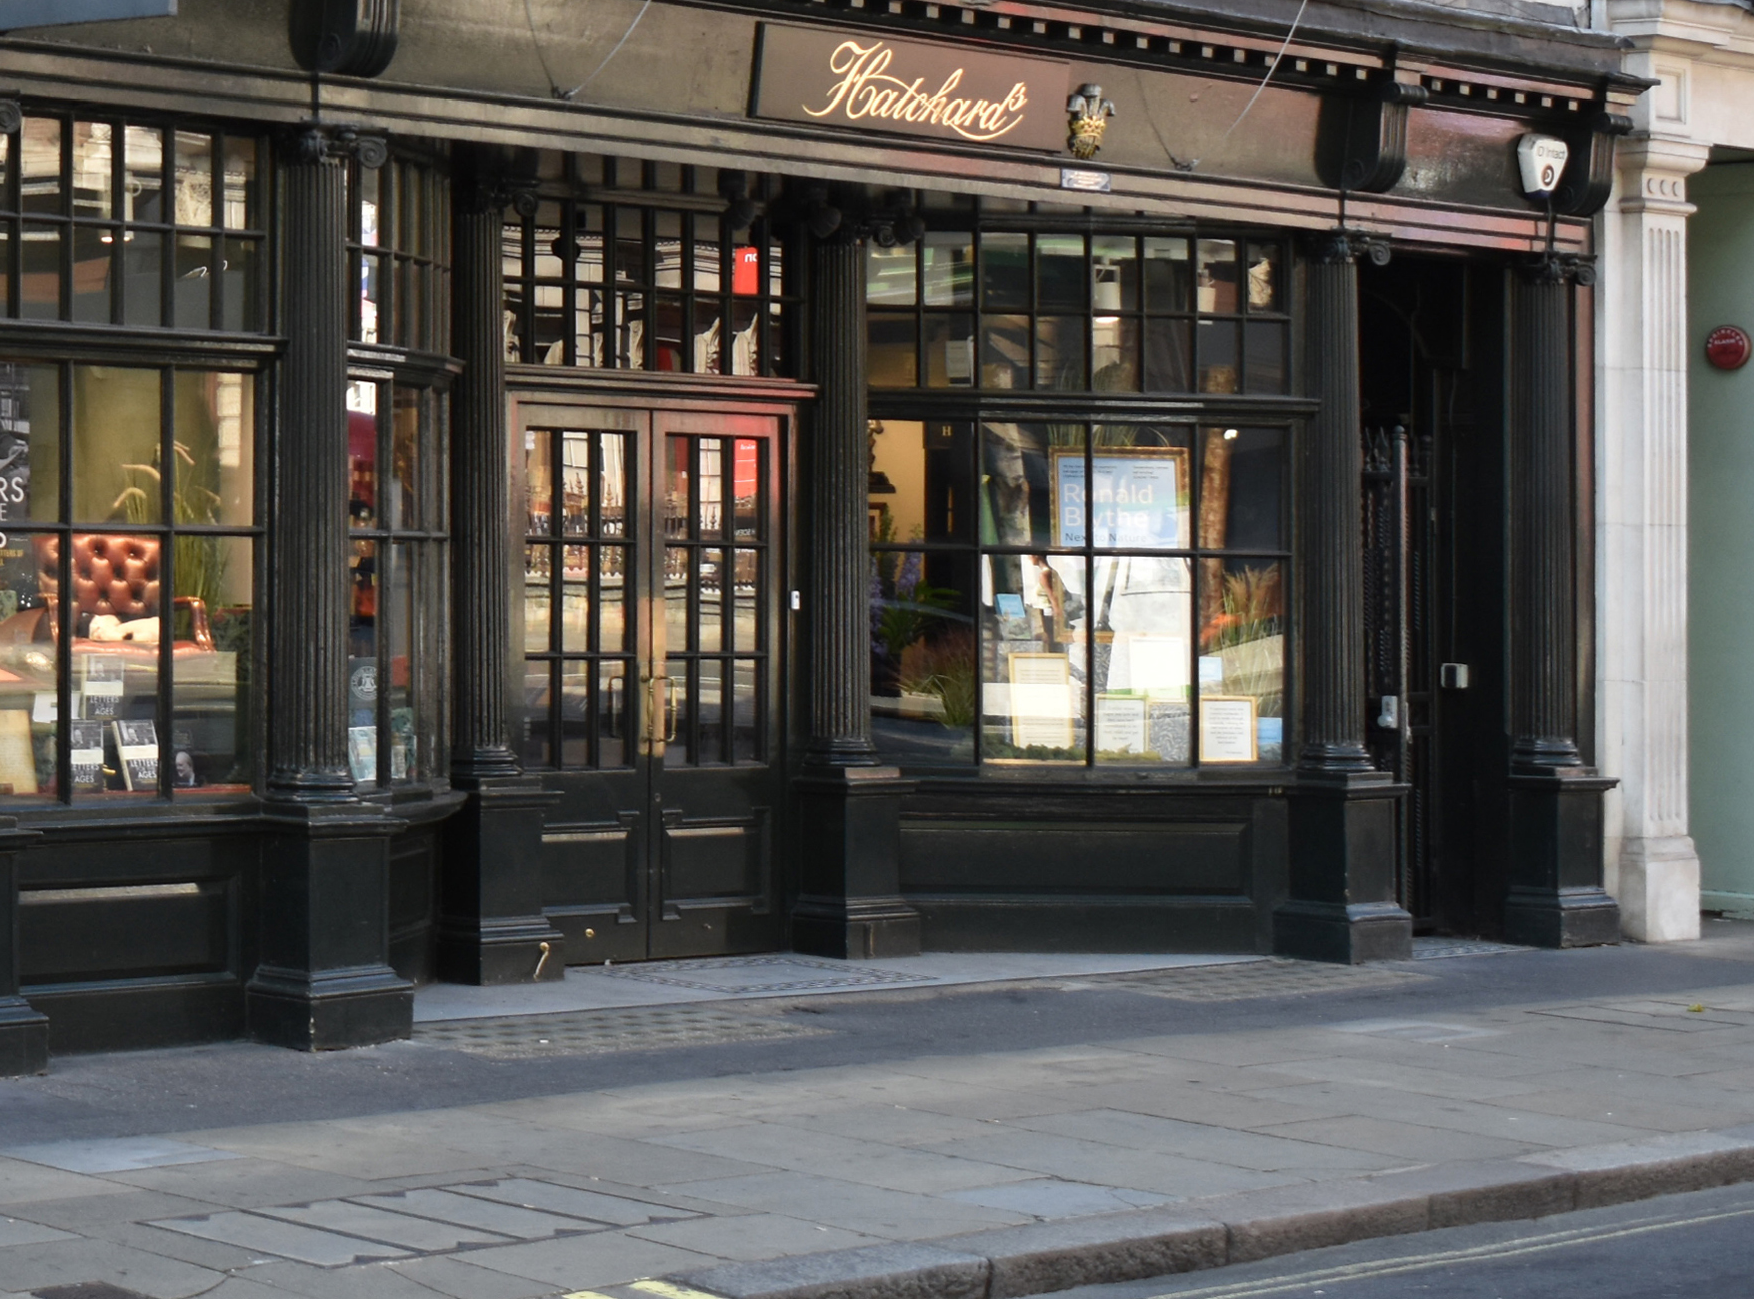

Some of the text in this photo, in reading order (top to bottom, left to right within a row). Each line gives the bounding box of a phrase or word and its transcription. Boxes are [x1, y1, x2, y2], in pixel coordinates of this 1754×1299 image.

[802, 41, 1027, 141] Hatchards
[1064, 507, 1150, 529] Bythe
[1065, 533, 1086, 542] Nex
[72, 763, 99, 771] ETTERS
[138, 770, 157, 778] AGES
[74, 775, 94, 783] AGES
